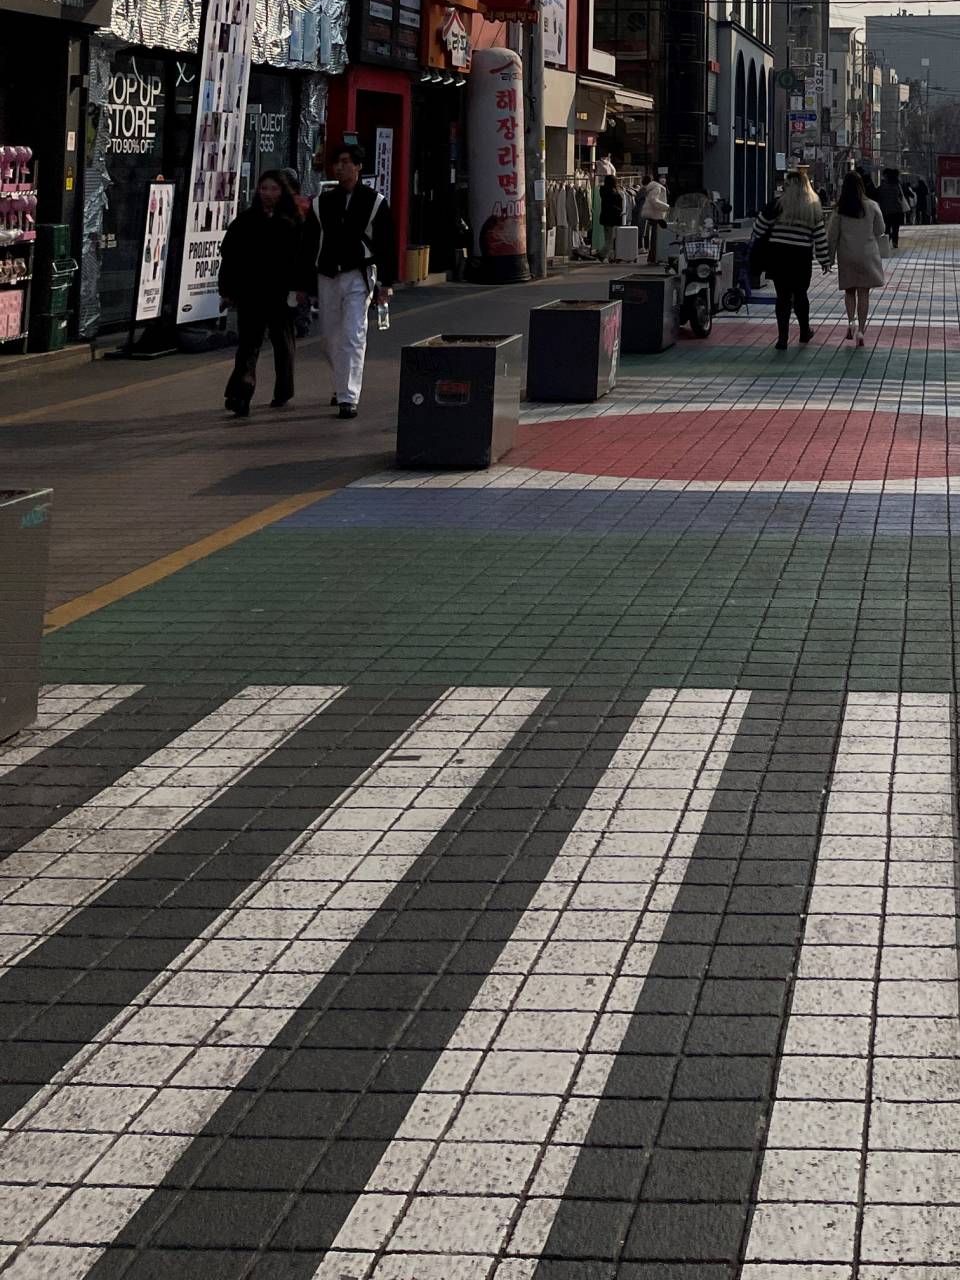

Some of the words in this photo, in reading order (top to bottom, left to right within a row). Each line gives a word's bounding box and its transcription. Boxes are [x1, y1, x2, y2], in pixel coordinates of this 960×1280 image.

[140, 74, 162, 107] UP
[112, 138, 123, 154] TO
[123, 139, 140, 154] 90%
[140, 139, 154, 154] OFF
[494, 87, 520, 197] 해장라면
[188, 240, 217, 260] PROJECT
